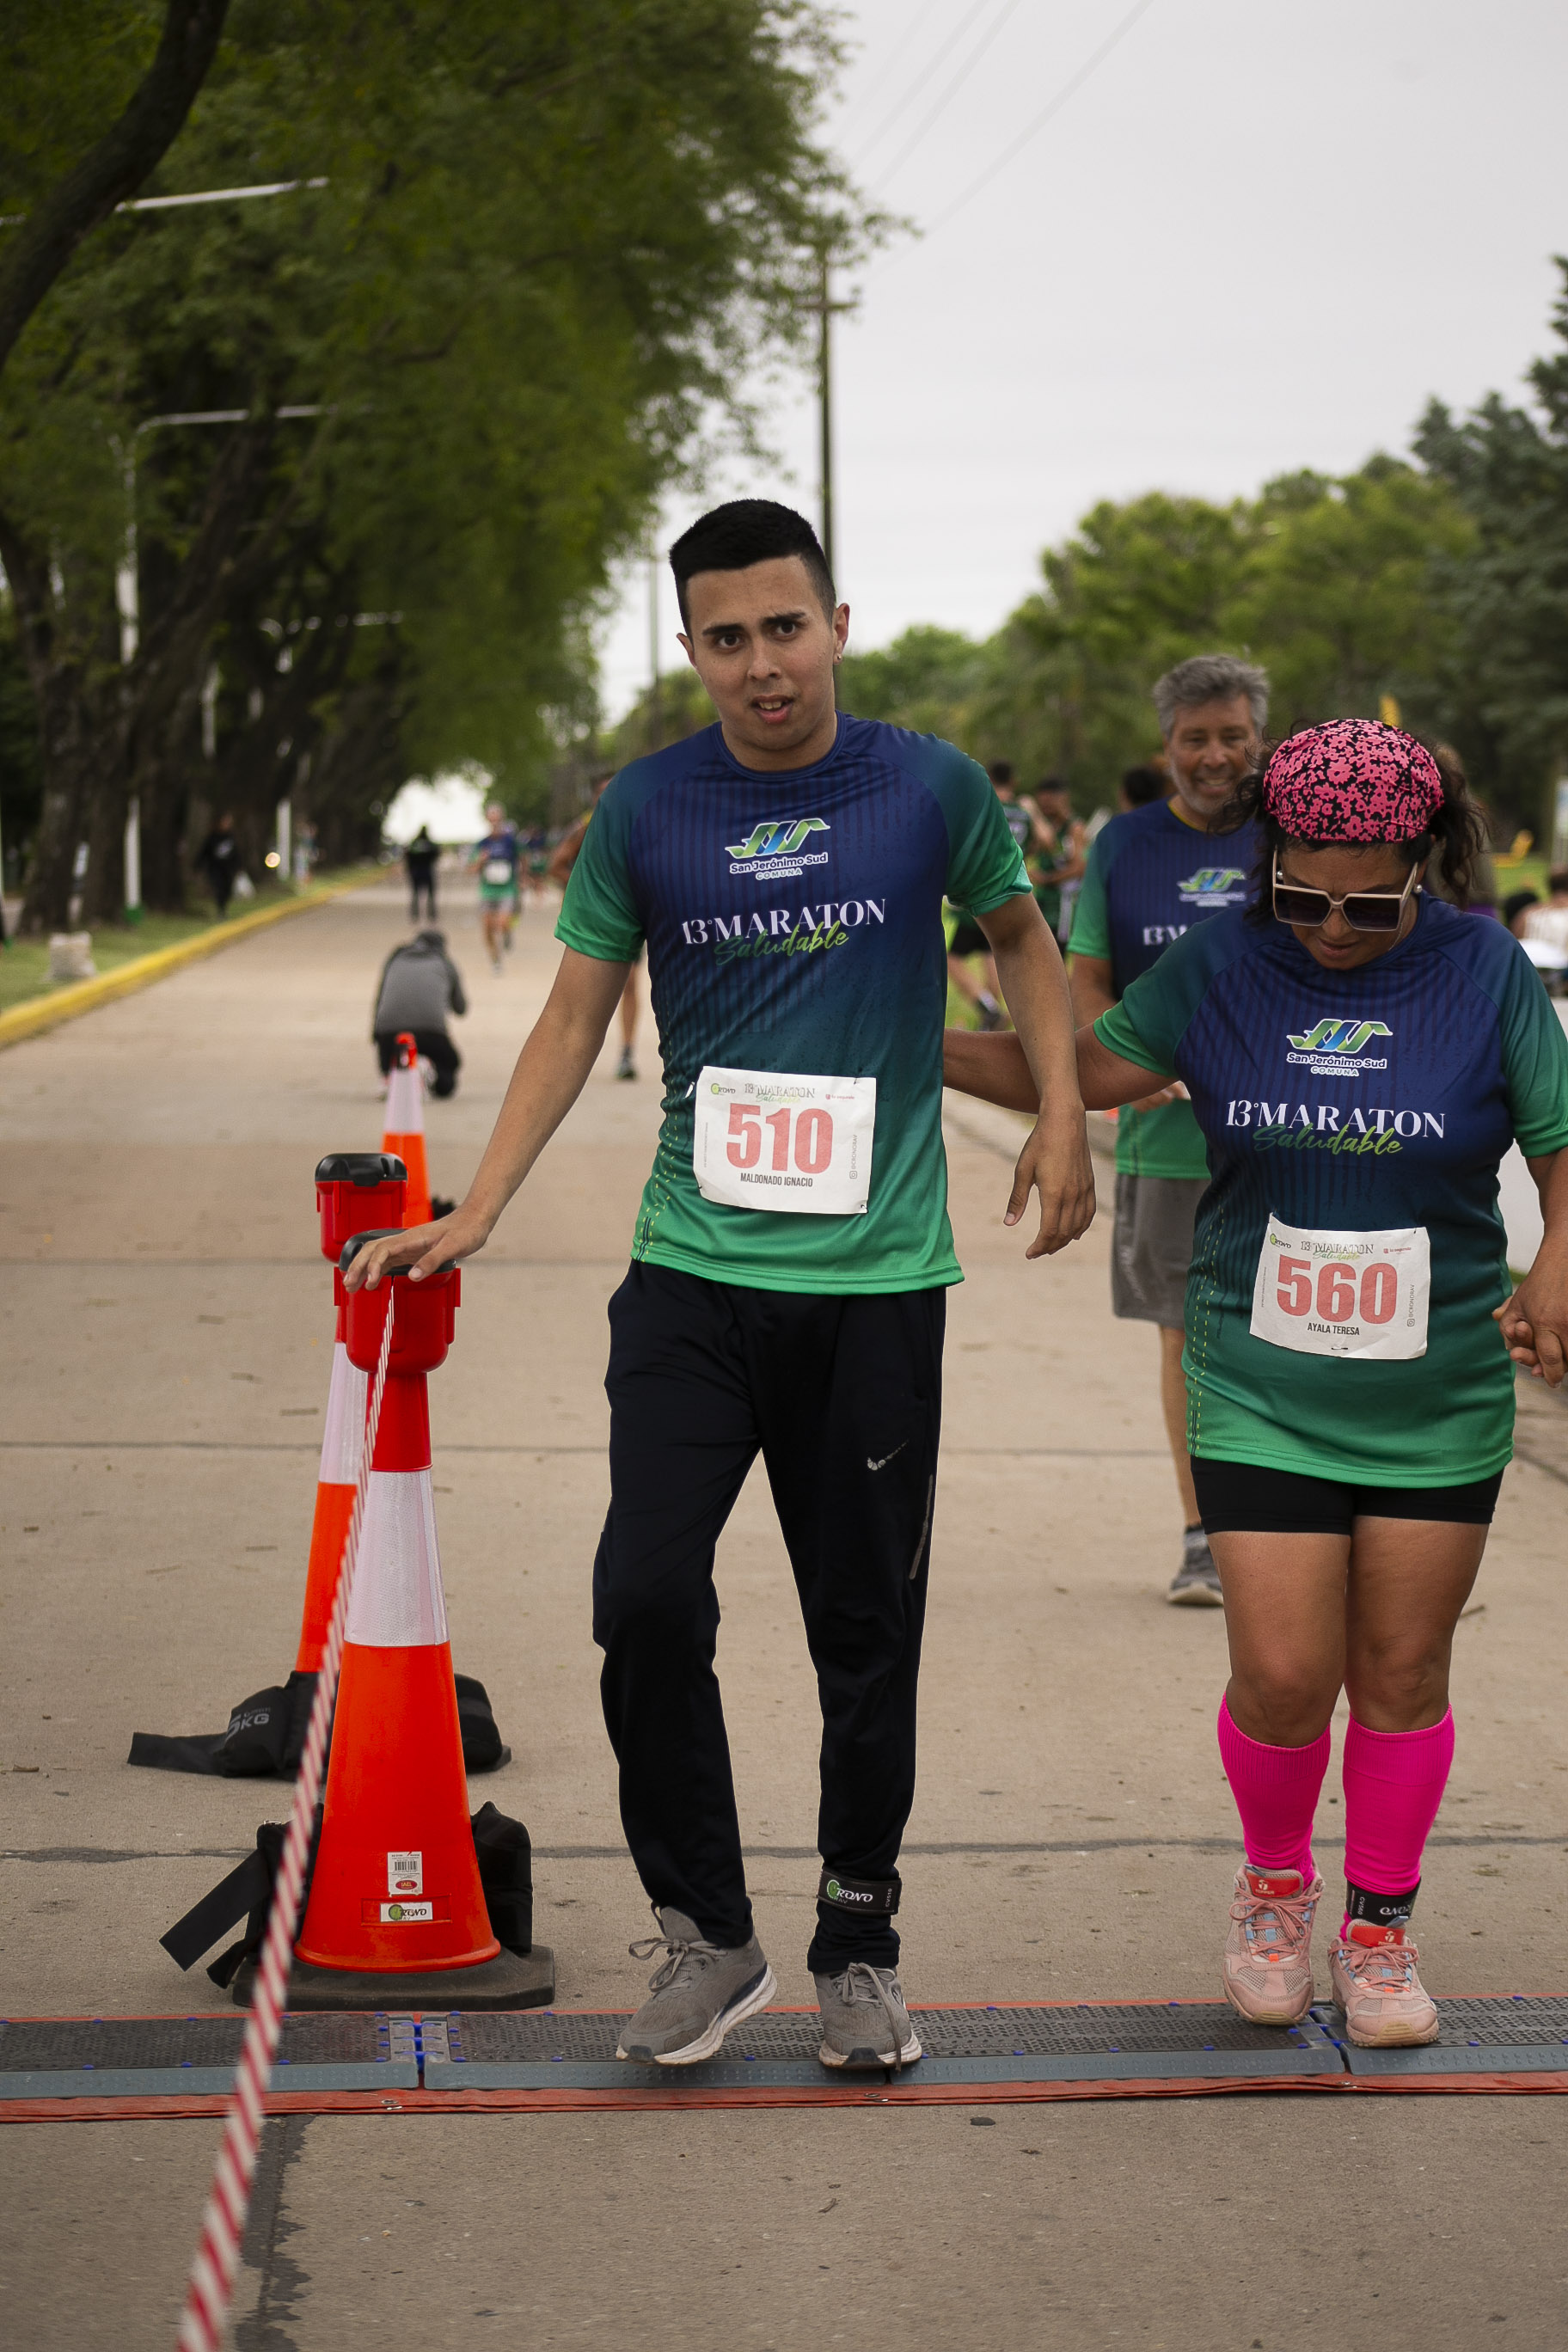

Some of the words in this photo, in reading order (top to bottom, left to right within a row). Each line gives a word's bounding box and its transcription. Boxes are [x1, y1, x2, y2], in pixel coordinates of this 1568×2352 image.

[731, 862, 751, 874] San
[754, 857, 804, 872] Jerónimo
[805, 853, 828, 865] Sud
[756, 867, 802, 880] COMUNA
[713, 920, 849, 966] Saludable
[1287, 1052, 1308, 1063] San
[1310, 1055, 1362, 1068] Jerónimo
[1364, 1058, 1387, 1069] Sud
[1311, 1066, 1359, 1077] COMUNA
[726, 1103, 834, 1174] 510
[1253, 1122, 1403, 1155] Saludable
[740, 1173, 782, 1186] MALDONADO
[784, 1176, 813, 1187] IGNACIO
[1277, 1253, 1398, 1324] 560
[1307, 1322, 1332, 1334] AYALA
[1332, 1326, 1360, 1335] TERESA
[827, 1879, 873, 1902] CRONO
